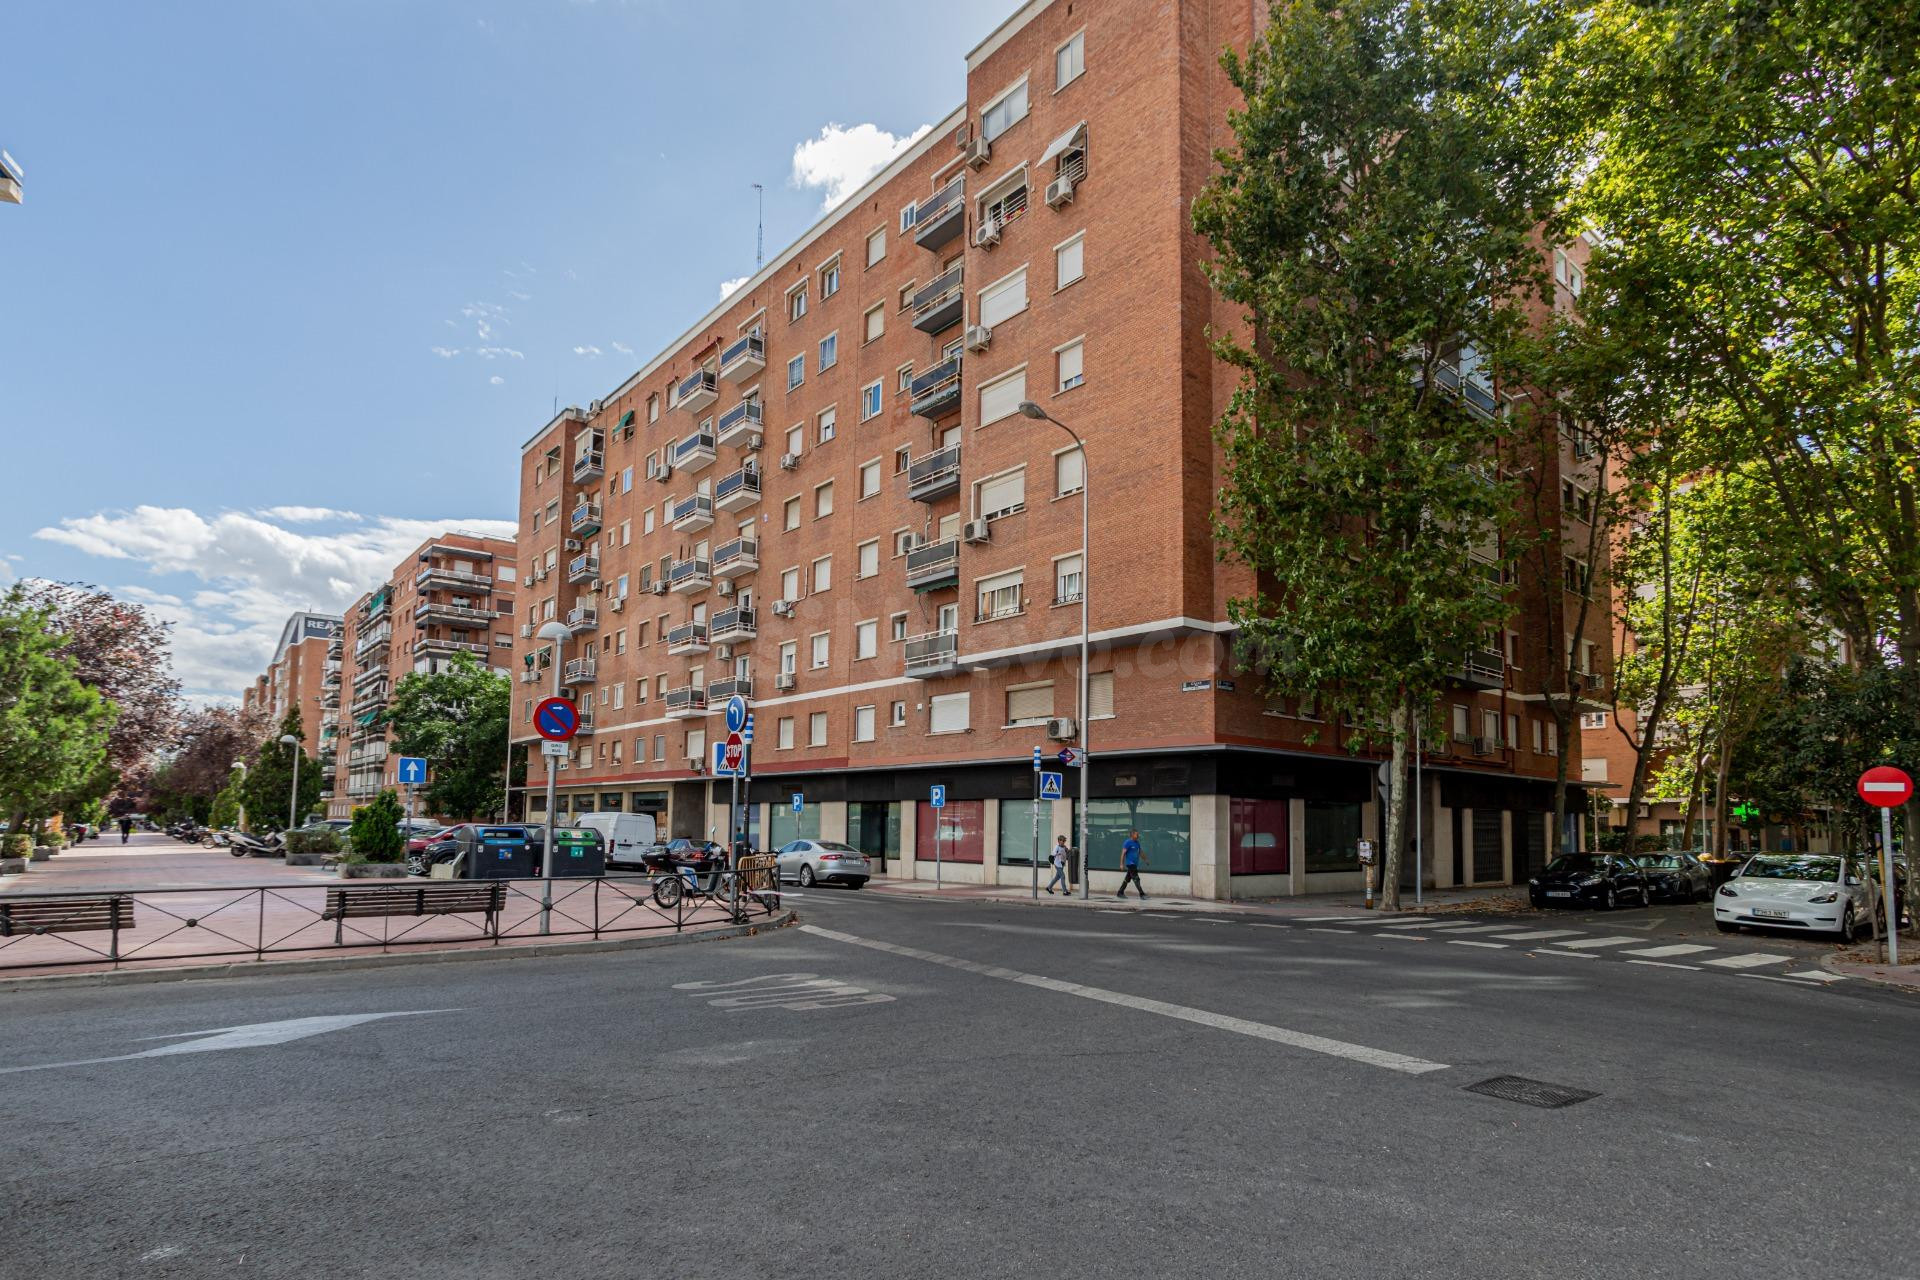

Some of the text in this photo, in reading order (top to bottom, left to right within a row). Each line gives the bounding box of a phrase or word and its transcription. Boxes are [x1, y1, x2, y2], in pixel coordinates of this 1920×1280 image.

[726, 744, 742, 758] STOP
[793, 795, 800, 809] P
[932, 788, 941, 803] P
